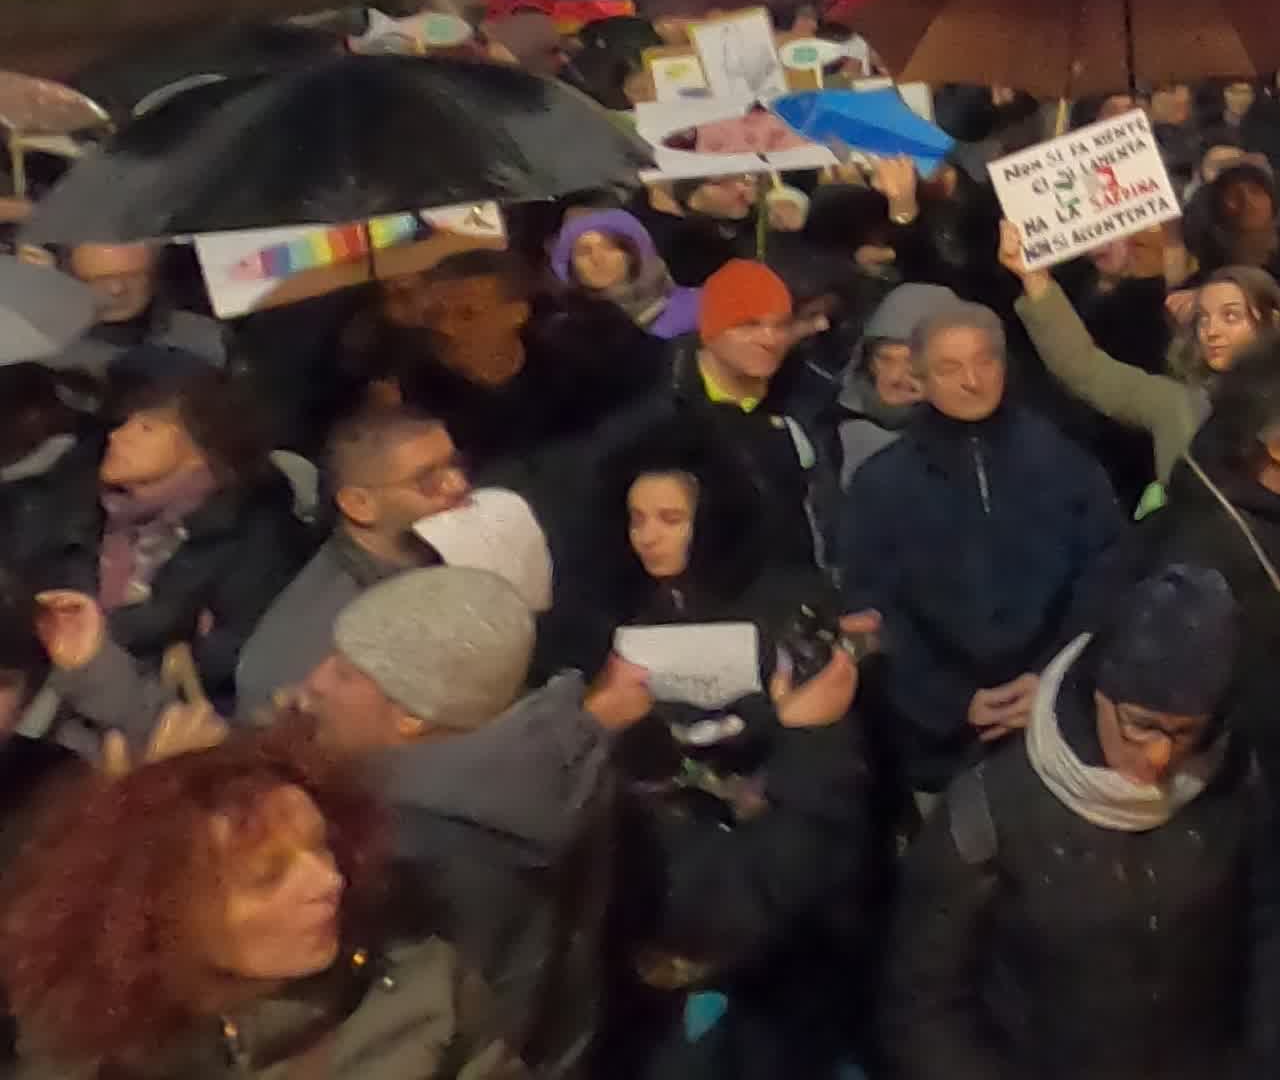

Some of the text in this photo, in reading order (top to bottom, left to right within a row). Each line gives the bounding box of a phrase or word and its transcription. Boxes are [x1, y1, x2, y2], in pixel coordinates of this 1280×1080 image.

[1031, 176, 1049, 195] CI
[1079, 137, 1147, 175] LAMENTA
[1045, 149, 1064, 167] SI
[1070, 141, 1089, 156] FA
[1093, 118, 1148, 147] NIENTE
[1024, 177, 1161, 237] MA LA SARDINA
[1072, 196, 1170, 243] ACCONTENTA
